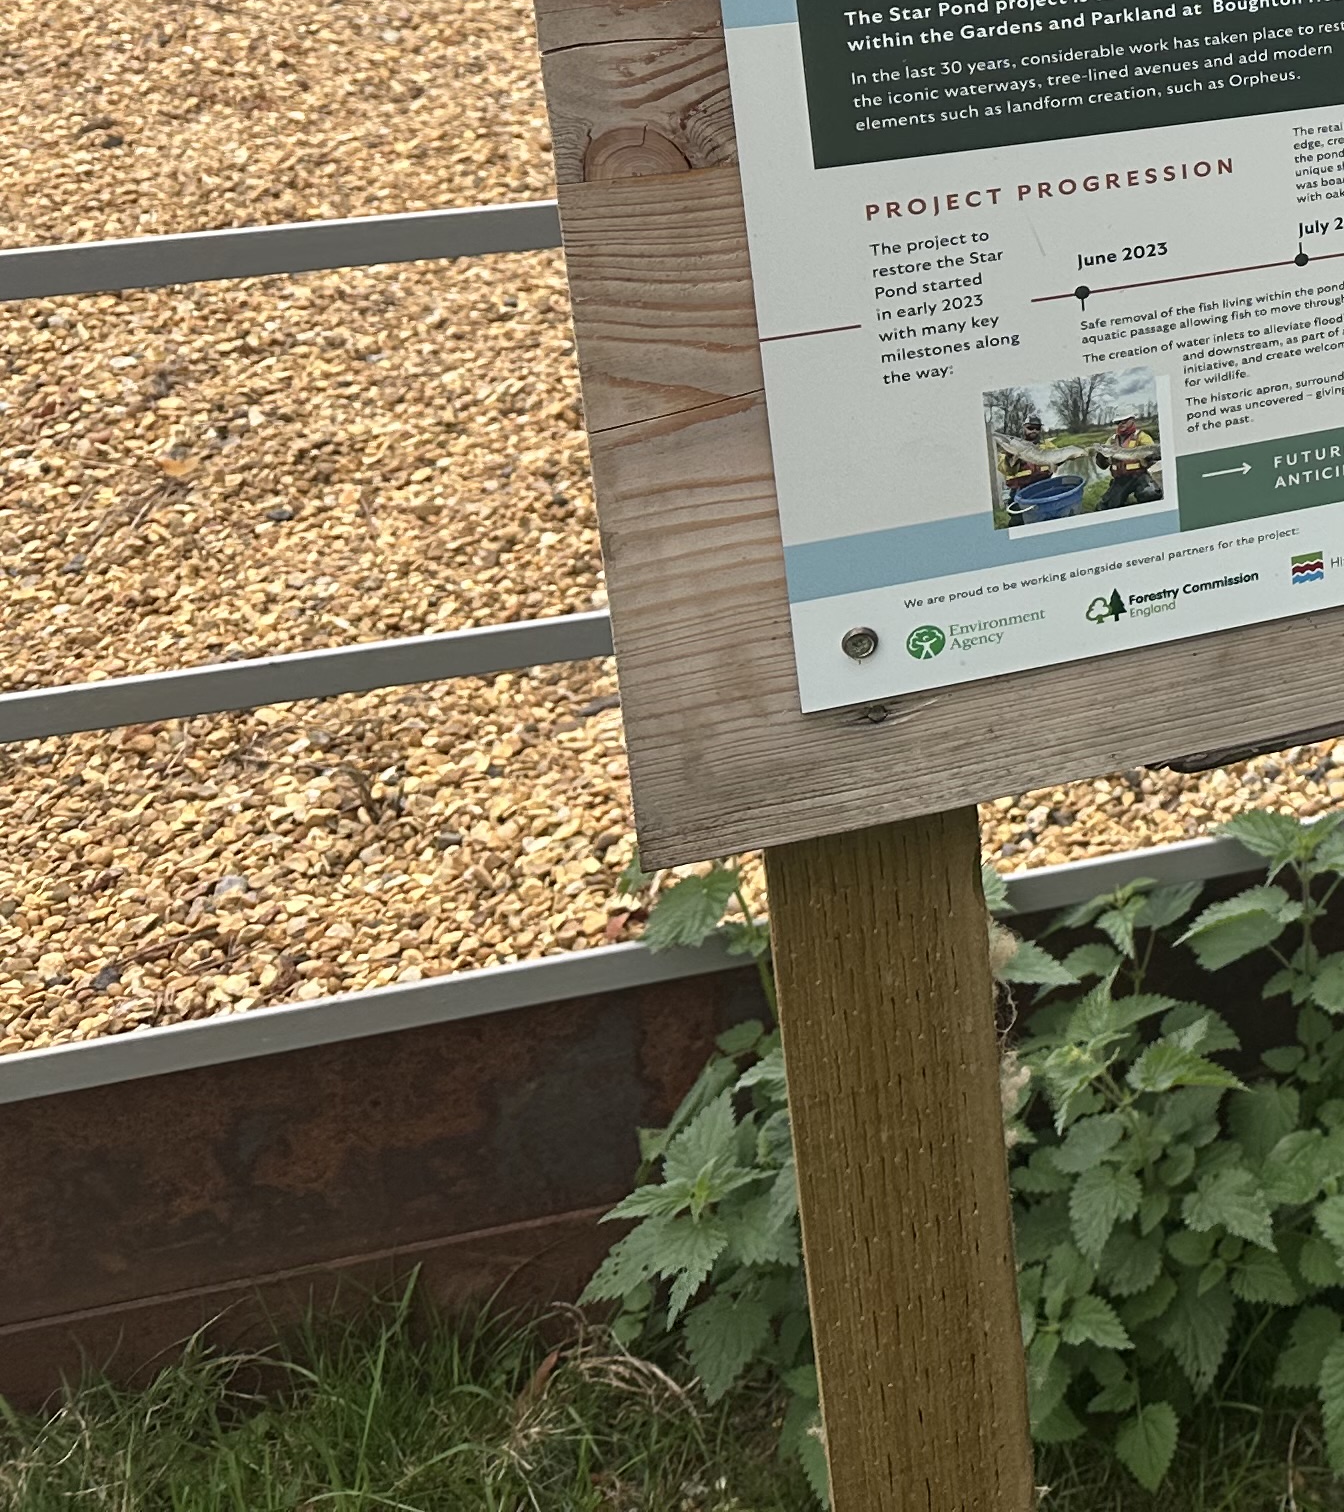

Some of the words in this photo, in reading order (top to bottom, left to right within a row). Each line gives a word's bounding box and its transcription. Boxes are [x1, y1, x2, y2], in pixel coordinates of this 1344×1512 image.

[843, 9, 883, 26] The
[888, 6, 932, 22] Star
[846, 31, 914, 52] within
[919, 27, 954, 44] the
[959, 20, 1043, 40] Gardens
[1048, 12, 1085, 31] and
[1090, 2, 1176, 26] Parkland
[1181, 3, 1202, 17] at
[851, 72, 867, 85] In
[871, 68, 901, 83] the
[904, 65, 936, 79] last
[940, 60, 962, 75] 30
[966, 58, 1017, 75] years,
[1020, 43, 1125, 67] considerable
[1128, 37, 1169, 54] work
[1173, 36, 1200, 50] has
[1203, 31, 1248, 46] taken
[1252, 26, 1294, 44] place
[1297, 25, 1314, 36] to
[852, 93, 883, 108] the
[887, 87, 939, 104] iconic
[944, 78, 1042, 98] waterways,
[1046, 64, 1129, 86] tree-lined
[1134, 60, 1199, 77] avenues
[1203, 52, 1233, 69] and
[1238, 48, 1268, 64] add
[1273, 43, 1332, 61] modern
[855, 112, 936, 131] elements
[940, 104, 979, 122] such
[984, 105, 1002, 117] as
[1006, 95, 1083, 114] landform
[1087, 86, 1162, 104] creation,
[1166, 78, 1203, 95] such
[1207, 79, 1225, 90] as
[1228, 70, 1301, 88] Orpheus.
[1291, 126, 1315, 137] The
[1293, 153, 1314, 164] the
[1294, 164, 1334, 177] unique
[865, 187, 1002, 221] PROJECT
[1017, 157, 1233, 201] PROGRESSION
[1295, 180, 1319, 190] was
[1295, 191, 1322, 204] with
[1298, 219, 1330, 239] July
[868, 241, 902, 257] The
[906, 233, 967, 255] project
[970, 231, 989, 243] to
[1077, 252, 1117, 271] June
[1121, 241, 1168, 262] 2023
[871, 261, 932, 278] restore
[936, 254, 965, 269] the
[968, 250, 1004, 265] Star
[874, 280, 917, 300] Pond
[922, 271, 983, 293] started
[876, 310, 892, 321] in
[896, 301, 937, 318] early
[941, 293, 984, 312] 2023
[1080, 317, 1107, 331] Safe
[1109, 309, 1158, 326] removal
[1159, 306, 1174, 318] of
[1175, 305, 1196, 316] the
[1198, 300, 1220, 313] fish
[1221, 297, 1253, 309] living
[1255, 290, 1292, 304] within
[1293, 287, 1314, 298] the
[878, 325, 917, 342] with
[921, 320, 967, 337] many
[970, 315, 1000, 329] key
[880, 341, 971, 364] milestones
[975, 333, 1020, 349] along
[882, 370, 911, 385] the
[1128, 587, 1180, 606] Forestry
[1181, 572, 1259, 595] Commission
[948, 609, 1045, 637] Environment
[1129, 601, 1176, 619] England
[949, 631, 1004, 651] Agency
